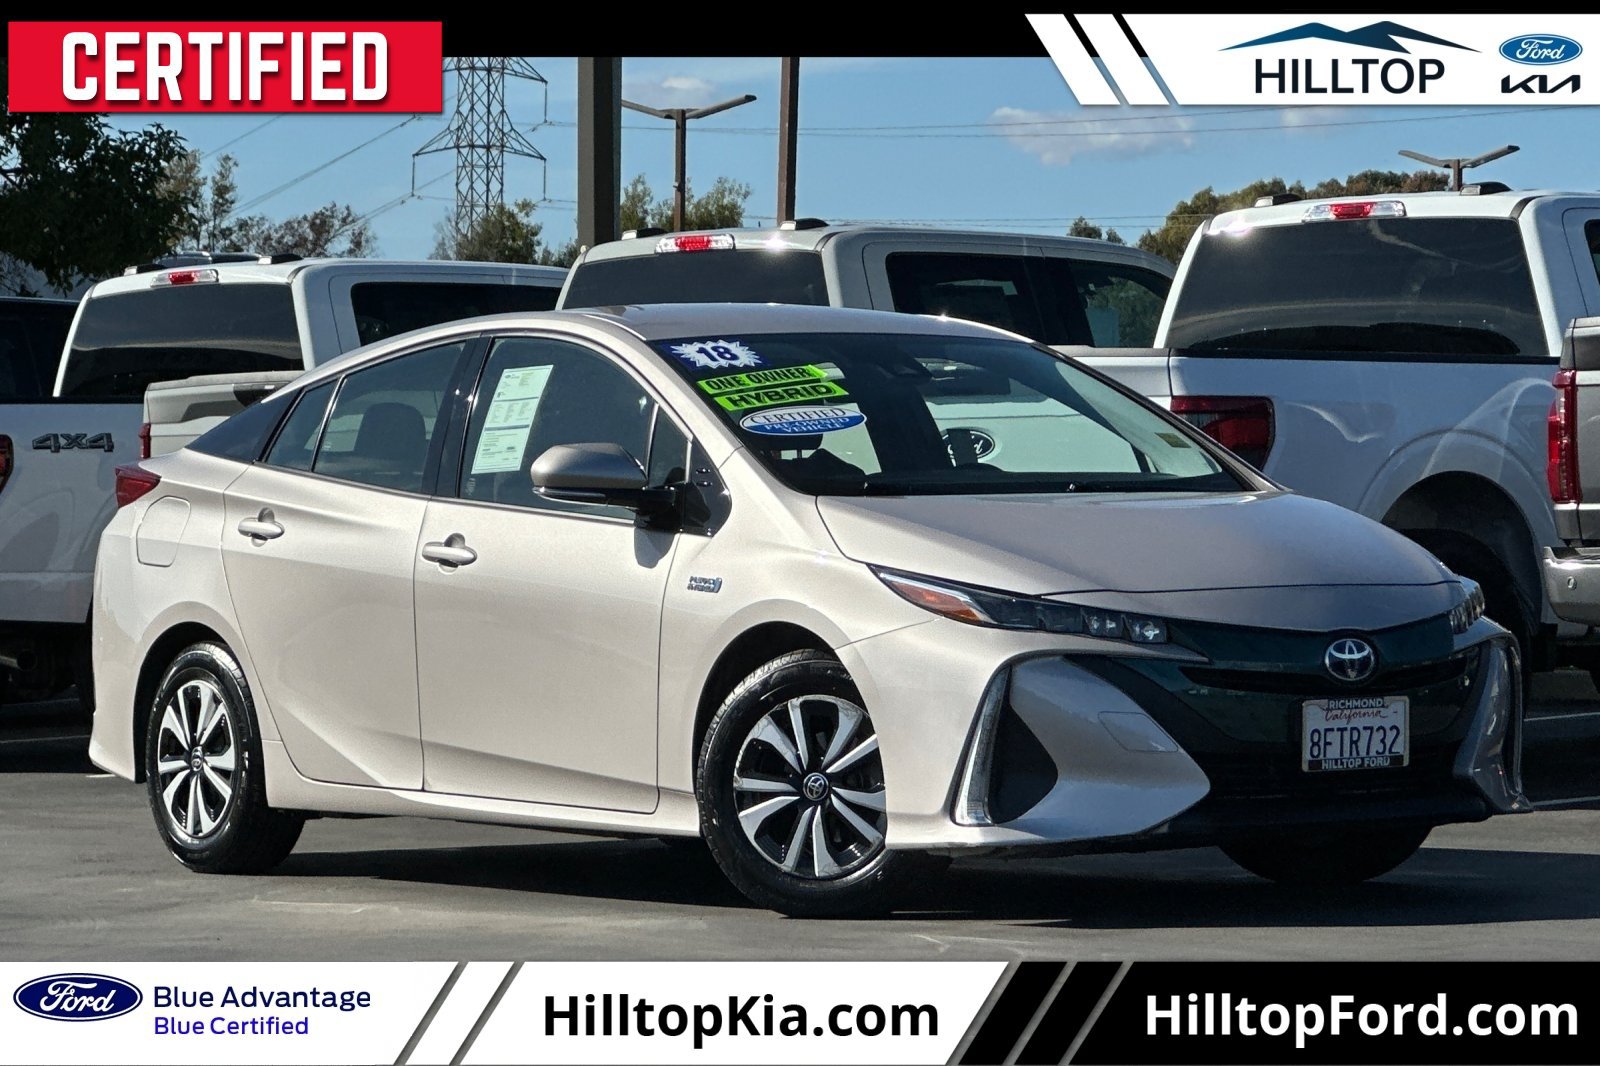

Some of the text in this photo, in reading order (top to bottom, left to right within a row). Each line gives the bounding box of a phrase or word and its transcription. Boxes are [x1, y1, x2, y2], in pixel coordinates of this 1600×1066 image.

[696, 345, 740, 362] 18
[707, 367, 814, 391] ONE OWNER
[725, 384, 836, 408] HYBRID
[750, 407, 846, 424] CERTIFIED
[764, 417, 850, 430] PRE-OWNED
[783, 423, 845, 433] VEHICLE
[1329, 698, 1383, 709] RICHMOND
[1324, 707, 1388, 725] California
[1310, 725, 1401, 758] 8FTR732
[1321, 757, 1391, 770] HILLTOP FORD
